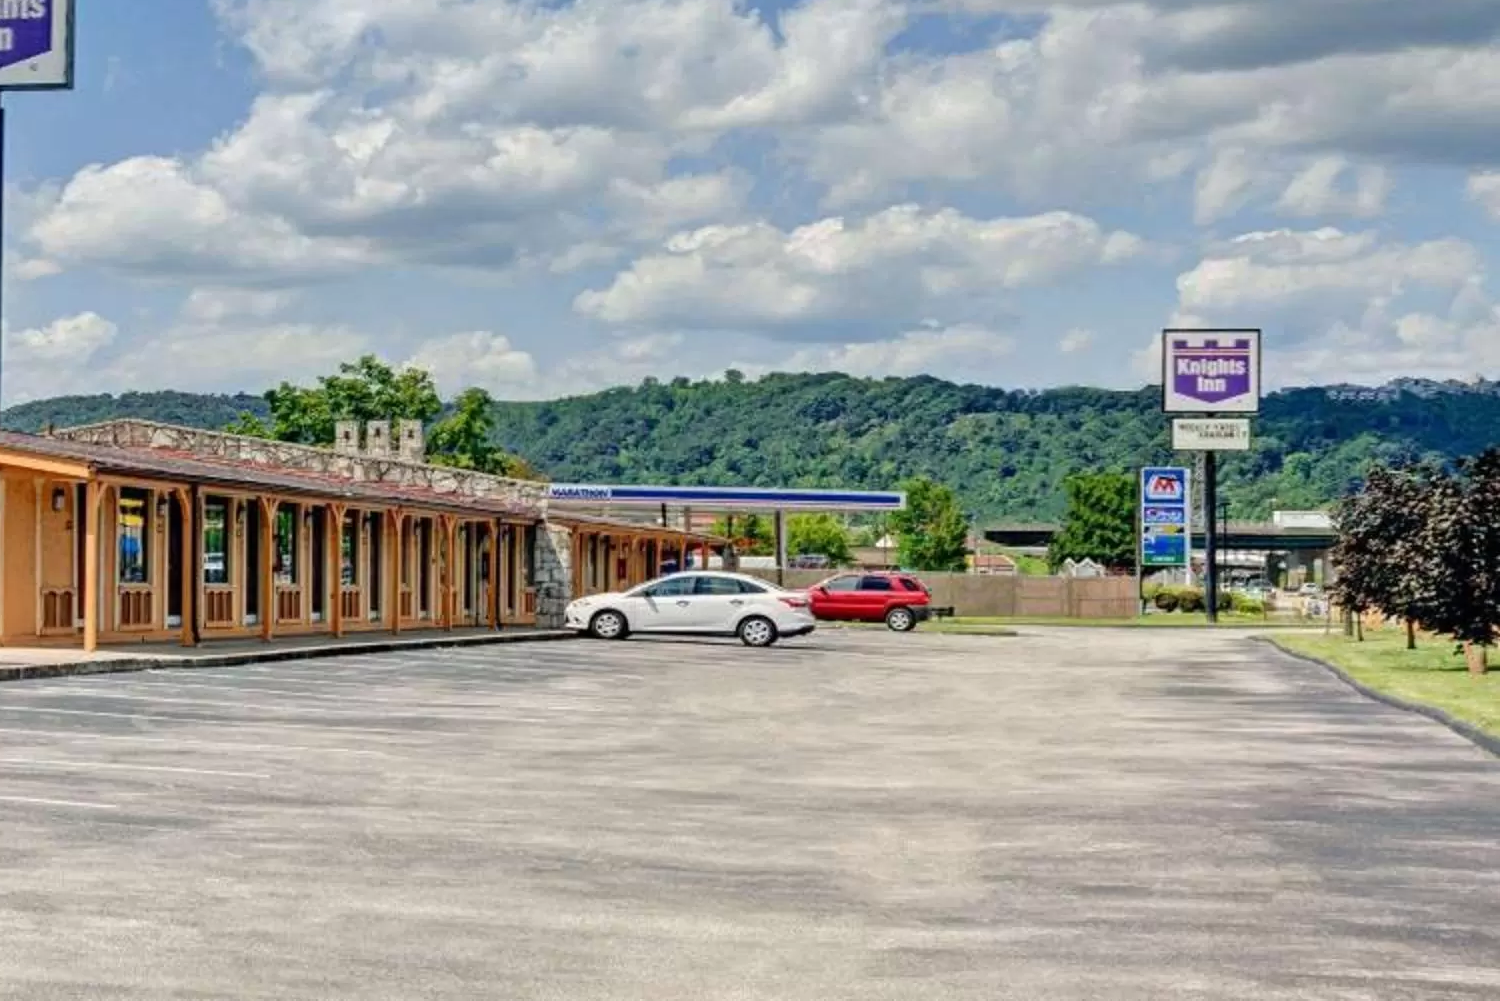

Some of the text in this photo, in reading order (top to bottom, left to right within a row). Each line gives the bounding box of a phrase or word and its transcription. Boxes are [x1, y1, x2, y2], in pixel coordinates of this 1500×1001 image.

[1177, 357, 1246, 377] Knights
[1196, 376, 1227, 392] Inn
[551, 487, 609, 498] MARATHON
